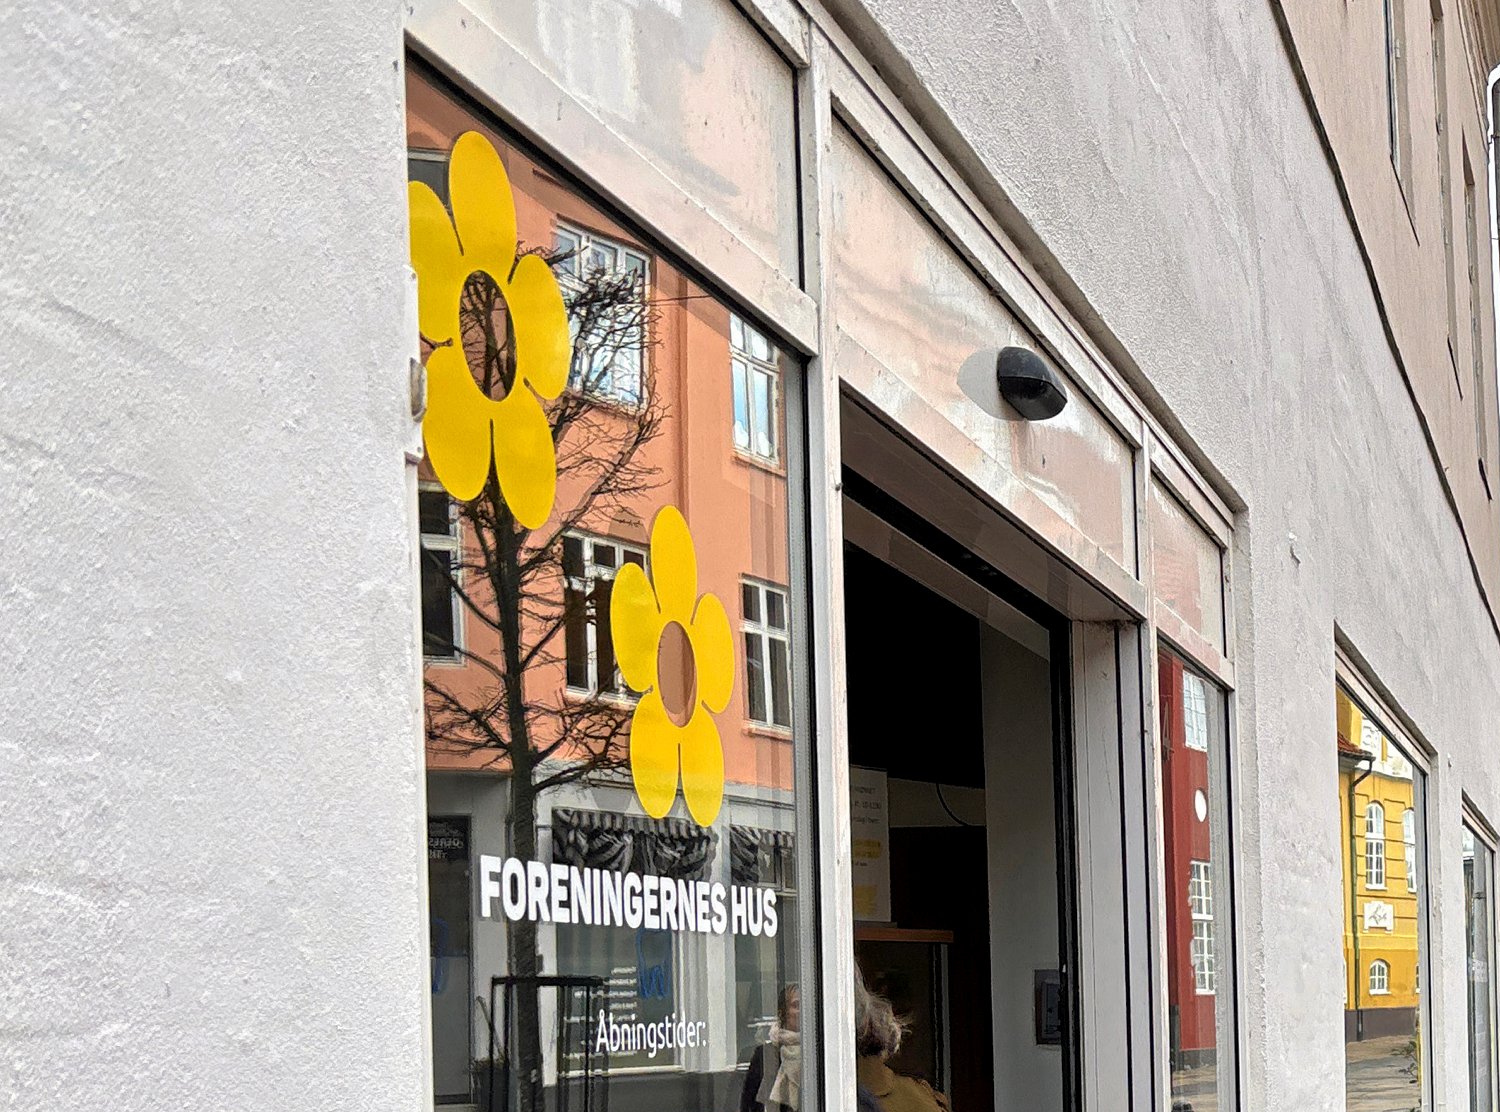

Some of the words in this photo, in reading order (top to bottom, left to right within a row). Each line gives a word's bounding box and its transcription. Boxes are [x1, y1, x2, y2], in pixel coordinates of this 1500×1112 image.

[479, 854, 728, 935] FORENINGERNES
[731, 888, 779, 938] HUS
[596, 1009, 707, 1058] Åbningstider:
